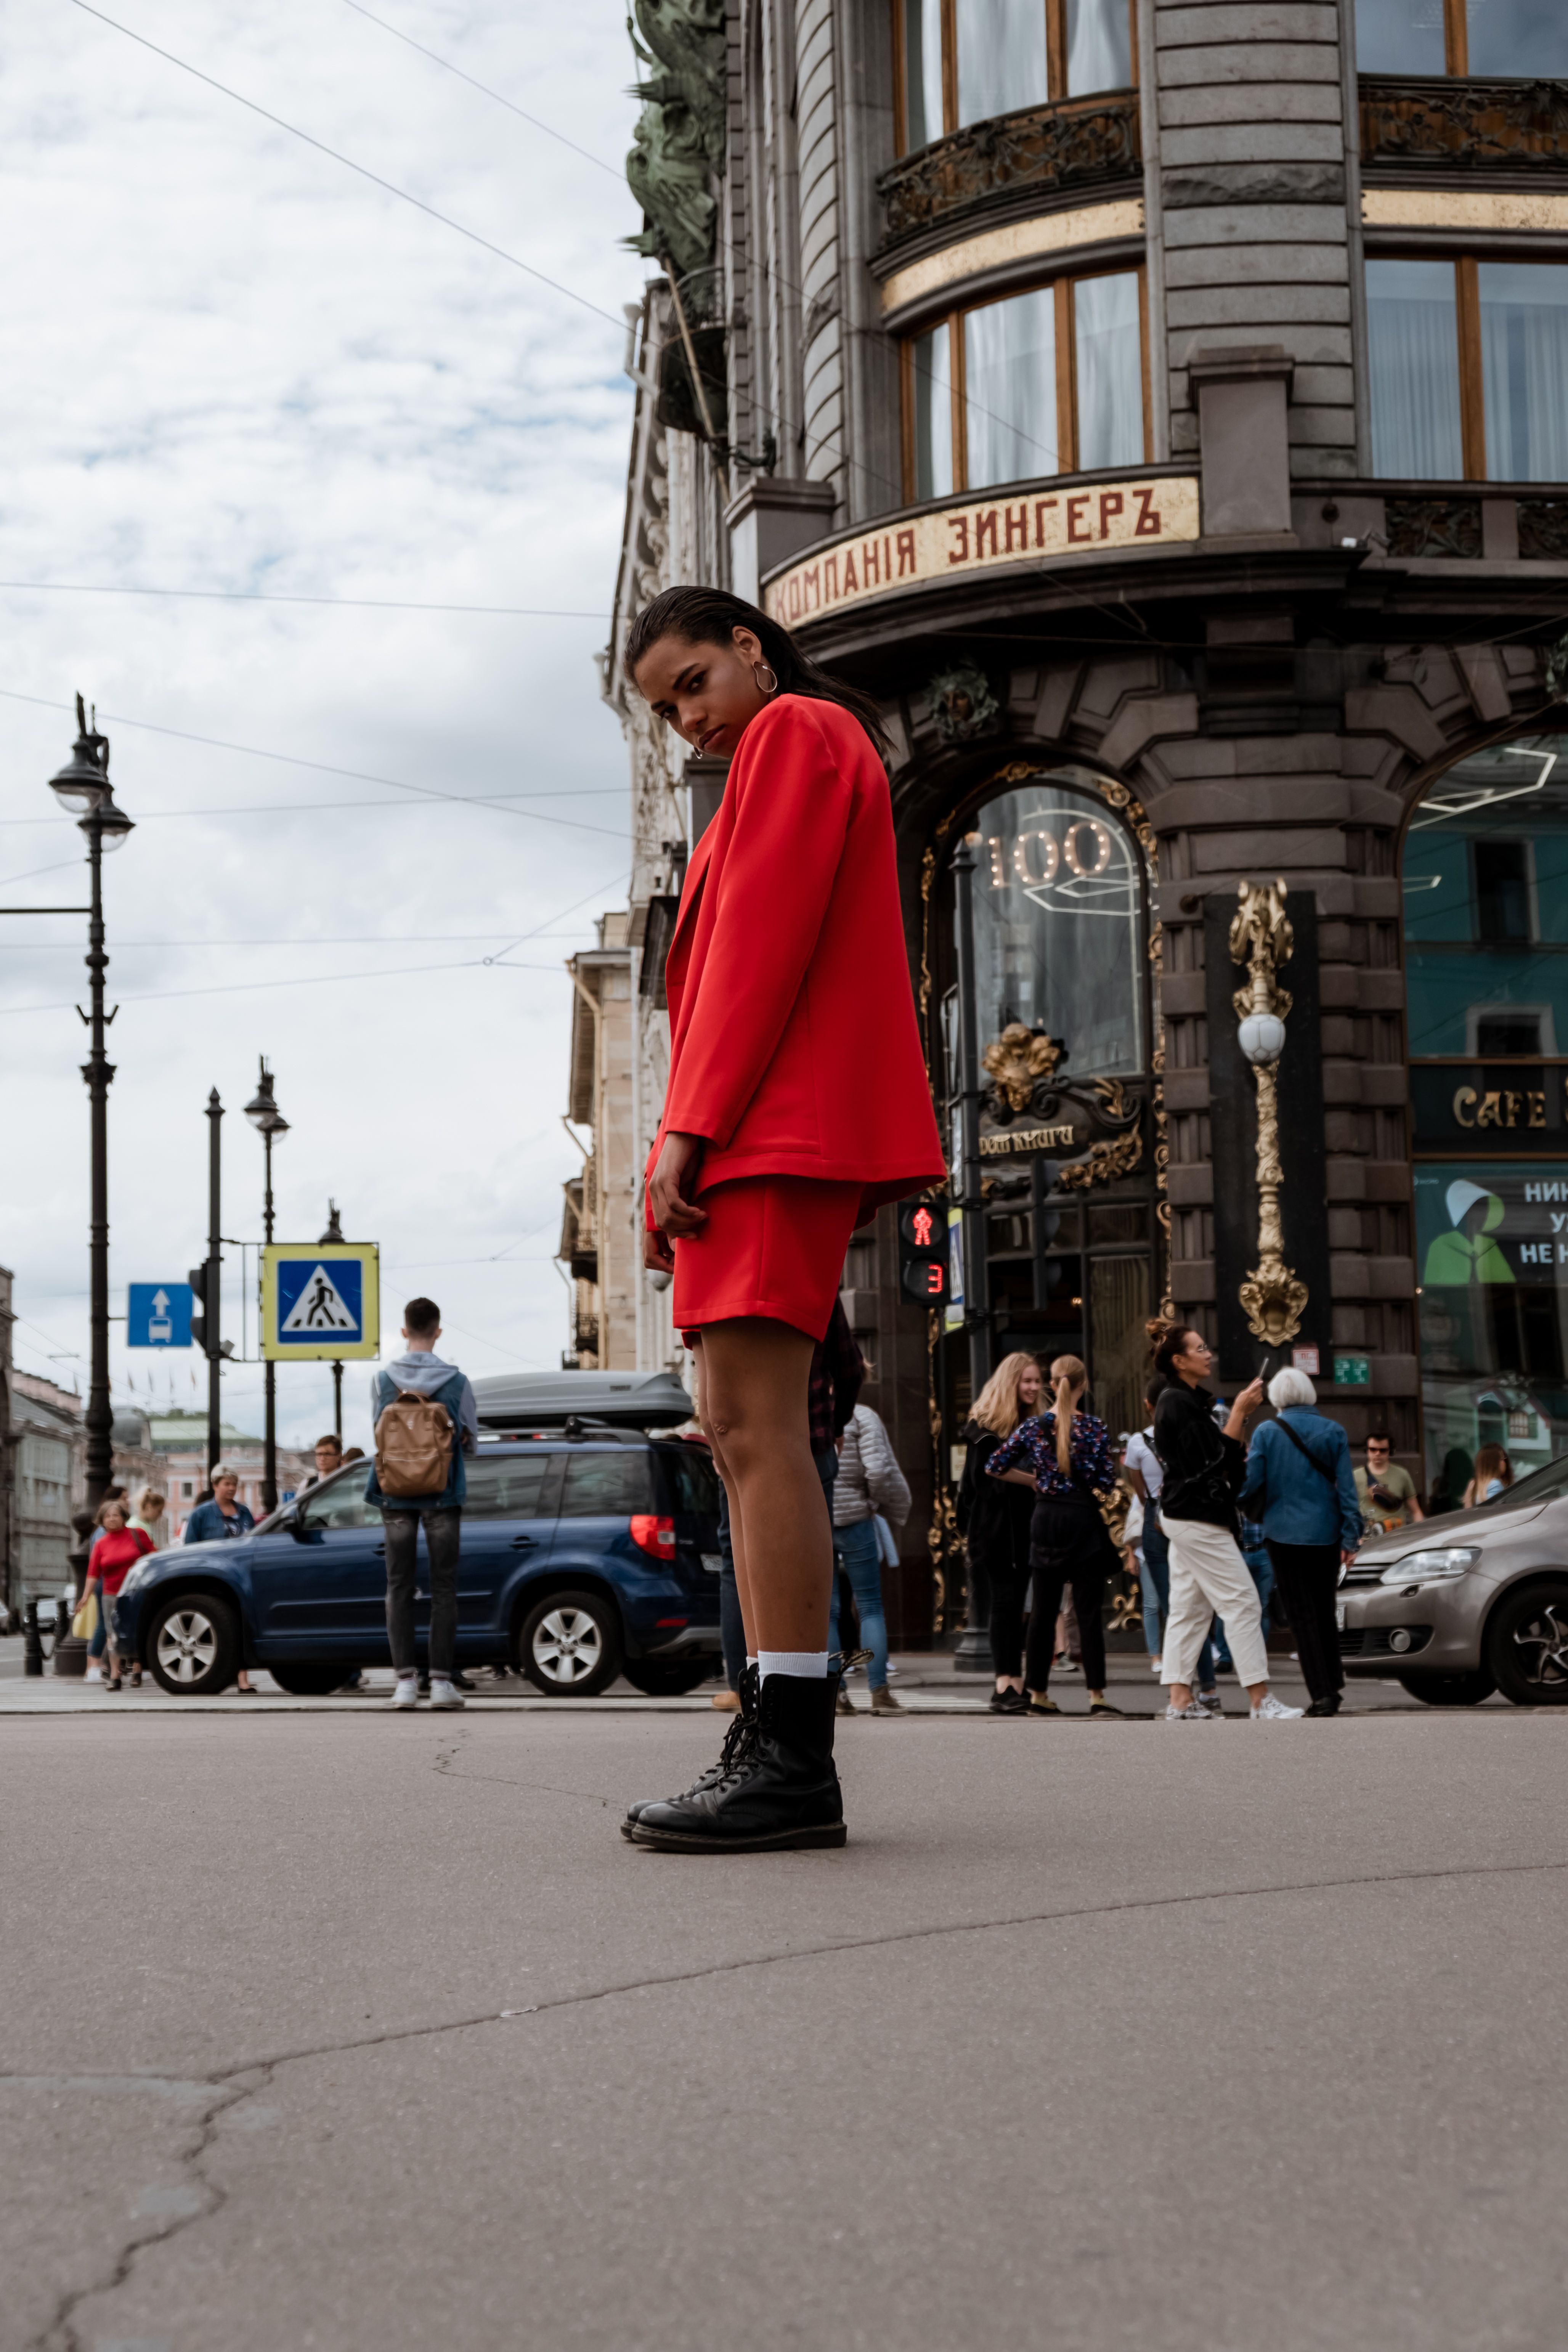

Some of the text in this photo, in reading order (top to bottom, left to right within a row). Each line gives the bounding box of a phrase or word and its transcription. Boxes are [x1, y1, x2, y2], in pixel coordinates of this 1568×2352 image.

[775, 489, 1161, 625] КОМПАНІЯ ЗИНГЕРЪ
[988, 821, 1111, 889] 100
[1453, 1085, 1546, 1128] CAFE
[1520, 1243, 1554, 1263] НЕ
[928, 1264, 942, 1292] 3
